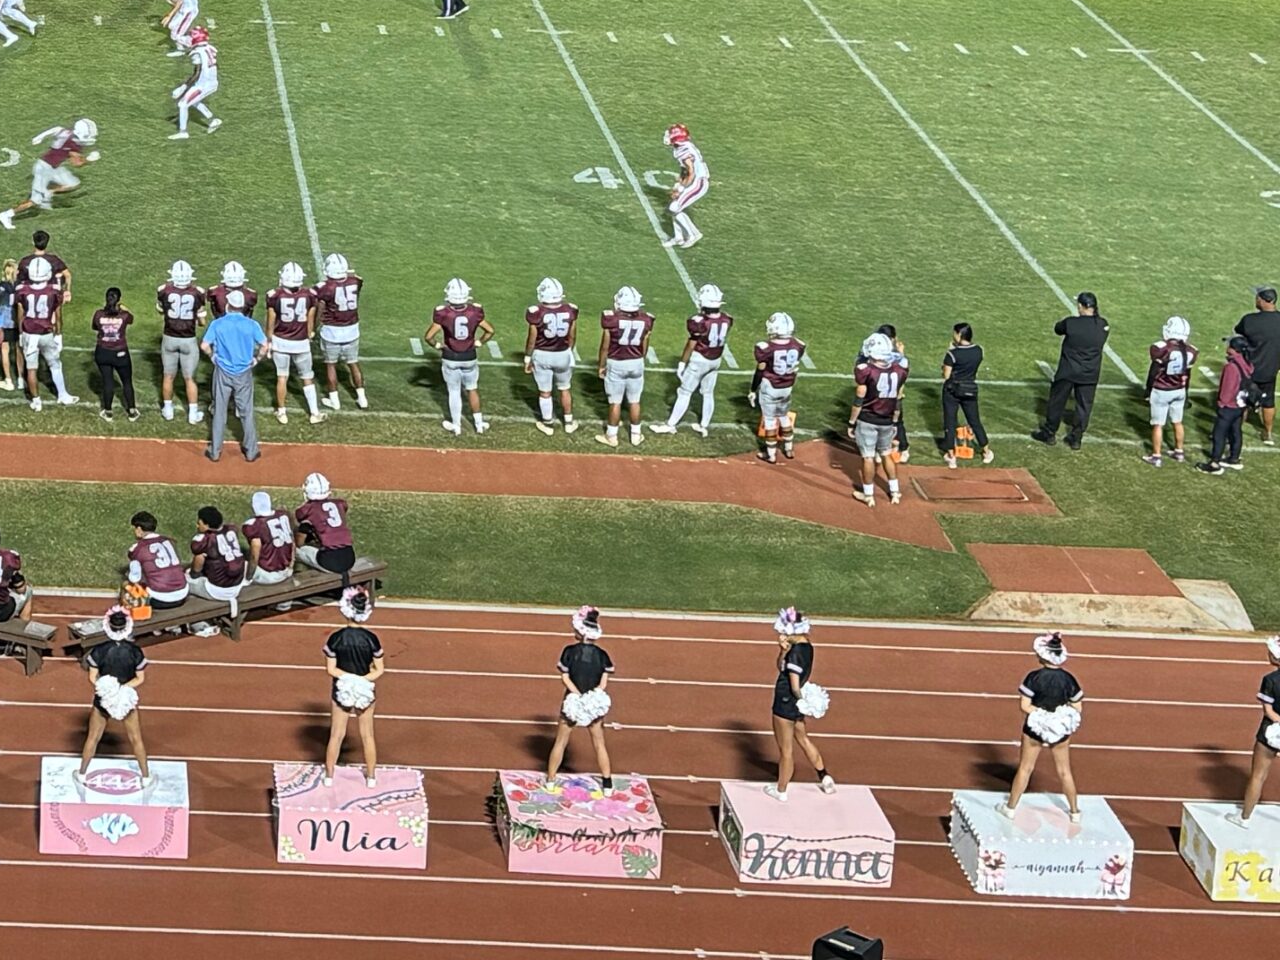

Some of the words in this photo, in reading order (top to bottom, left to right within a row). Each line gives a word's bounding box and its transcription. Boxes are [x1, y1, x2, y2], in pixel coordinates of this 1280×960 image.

[26, 293, 48, 318] 14
[167, 293, 194, 320] 32
[279, 296, 307, 322] 54
[334, 283, 357, 312] 45
[453, 314, 469, 341] 6
[542, 312, 570, 339] 35
[617, 319, 645, 346] 77
[876, 371, 898, 399] 41
[321, 500, 342, 528] 3
[149, 539, 180, 569] 31
[297, 818, 409, 853] Mia
